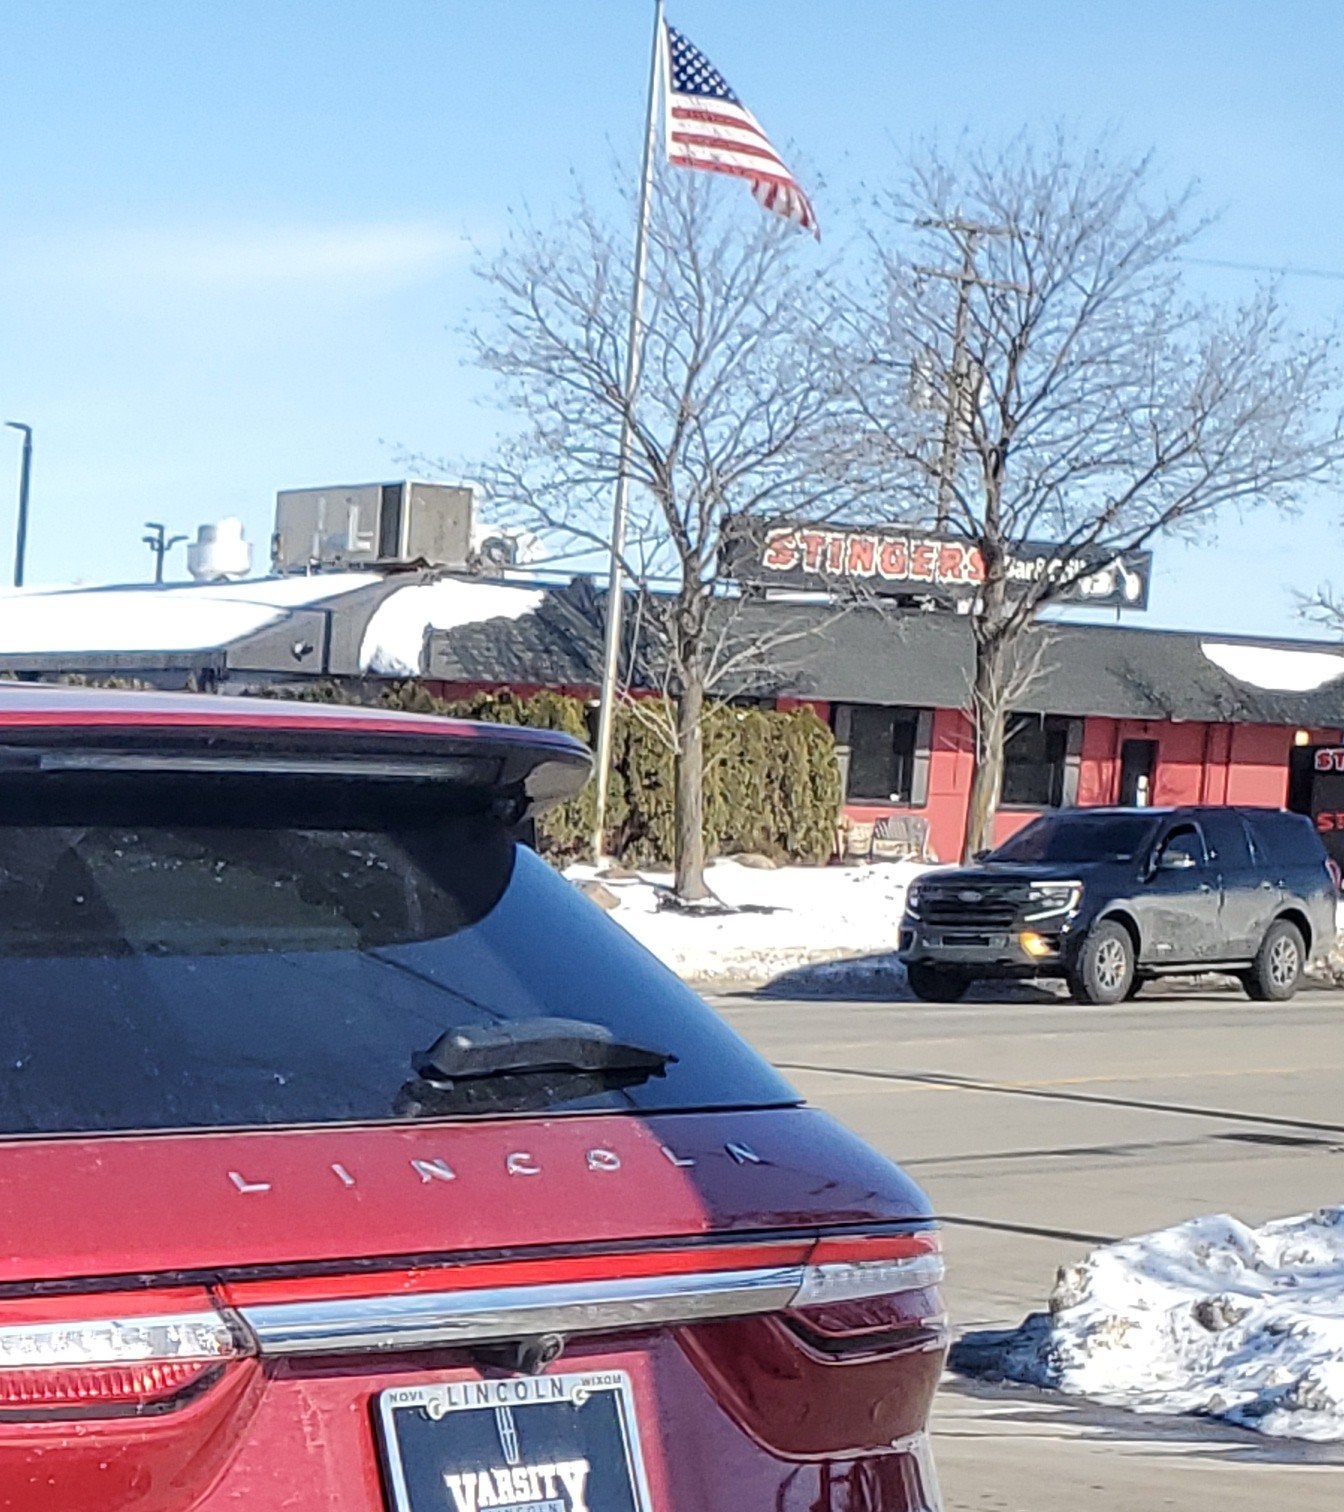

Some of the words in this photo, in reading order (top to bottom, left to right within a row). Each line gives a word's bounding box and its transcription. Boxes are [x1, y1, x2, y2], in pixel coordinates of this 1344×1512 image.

[762, 527, 986, 586] STINGERS
[228, 1140, 762, 1195] LINCOLN
[389, 1392, 424, 1403] NOVI
[447, 1377, 564, 1407] LINCOLN
[580, 1374, 622, 1387] WIXOM
